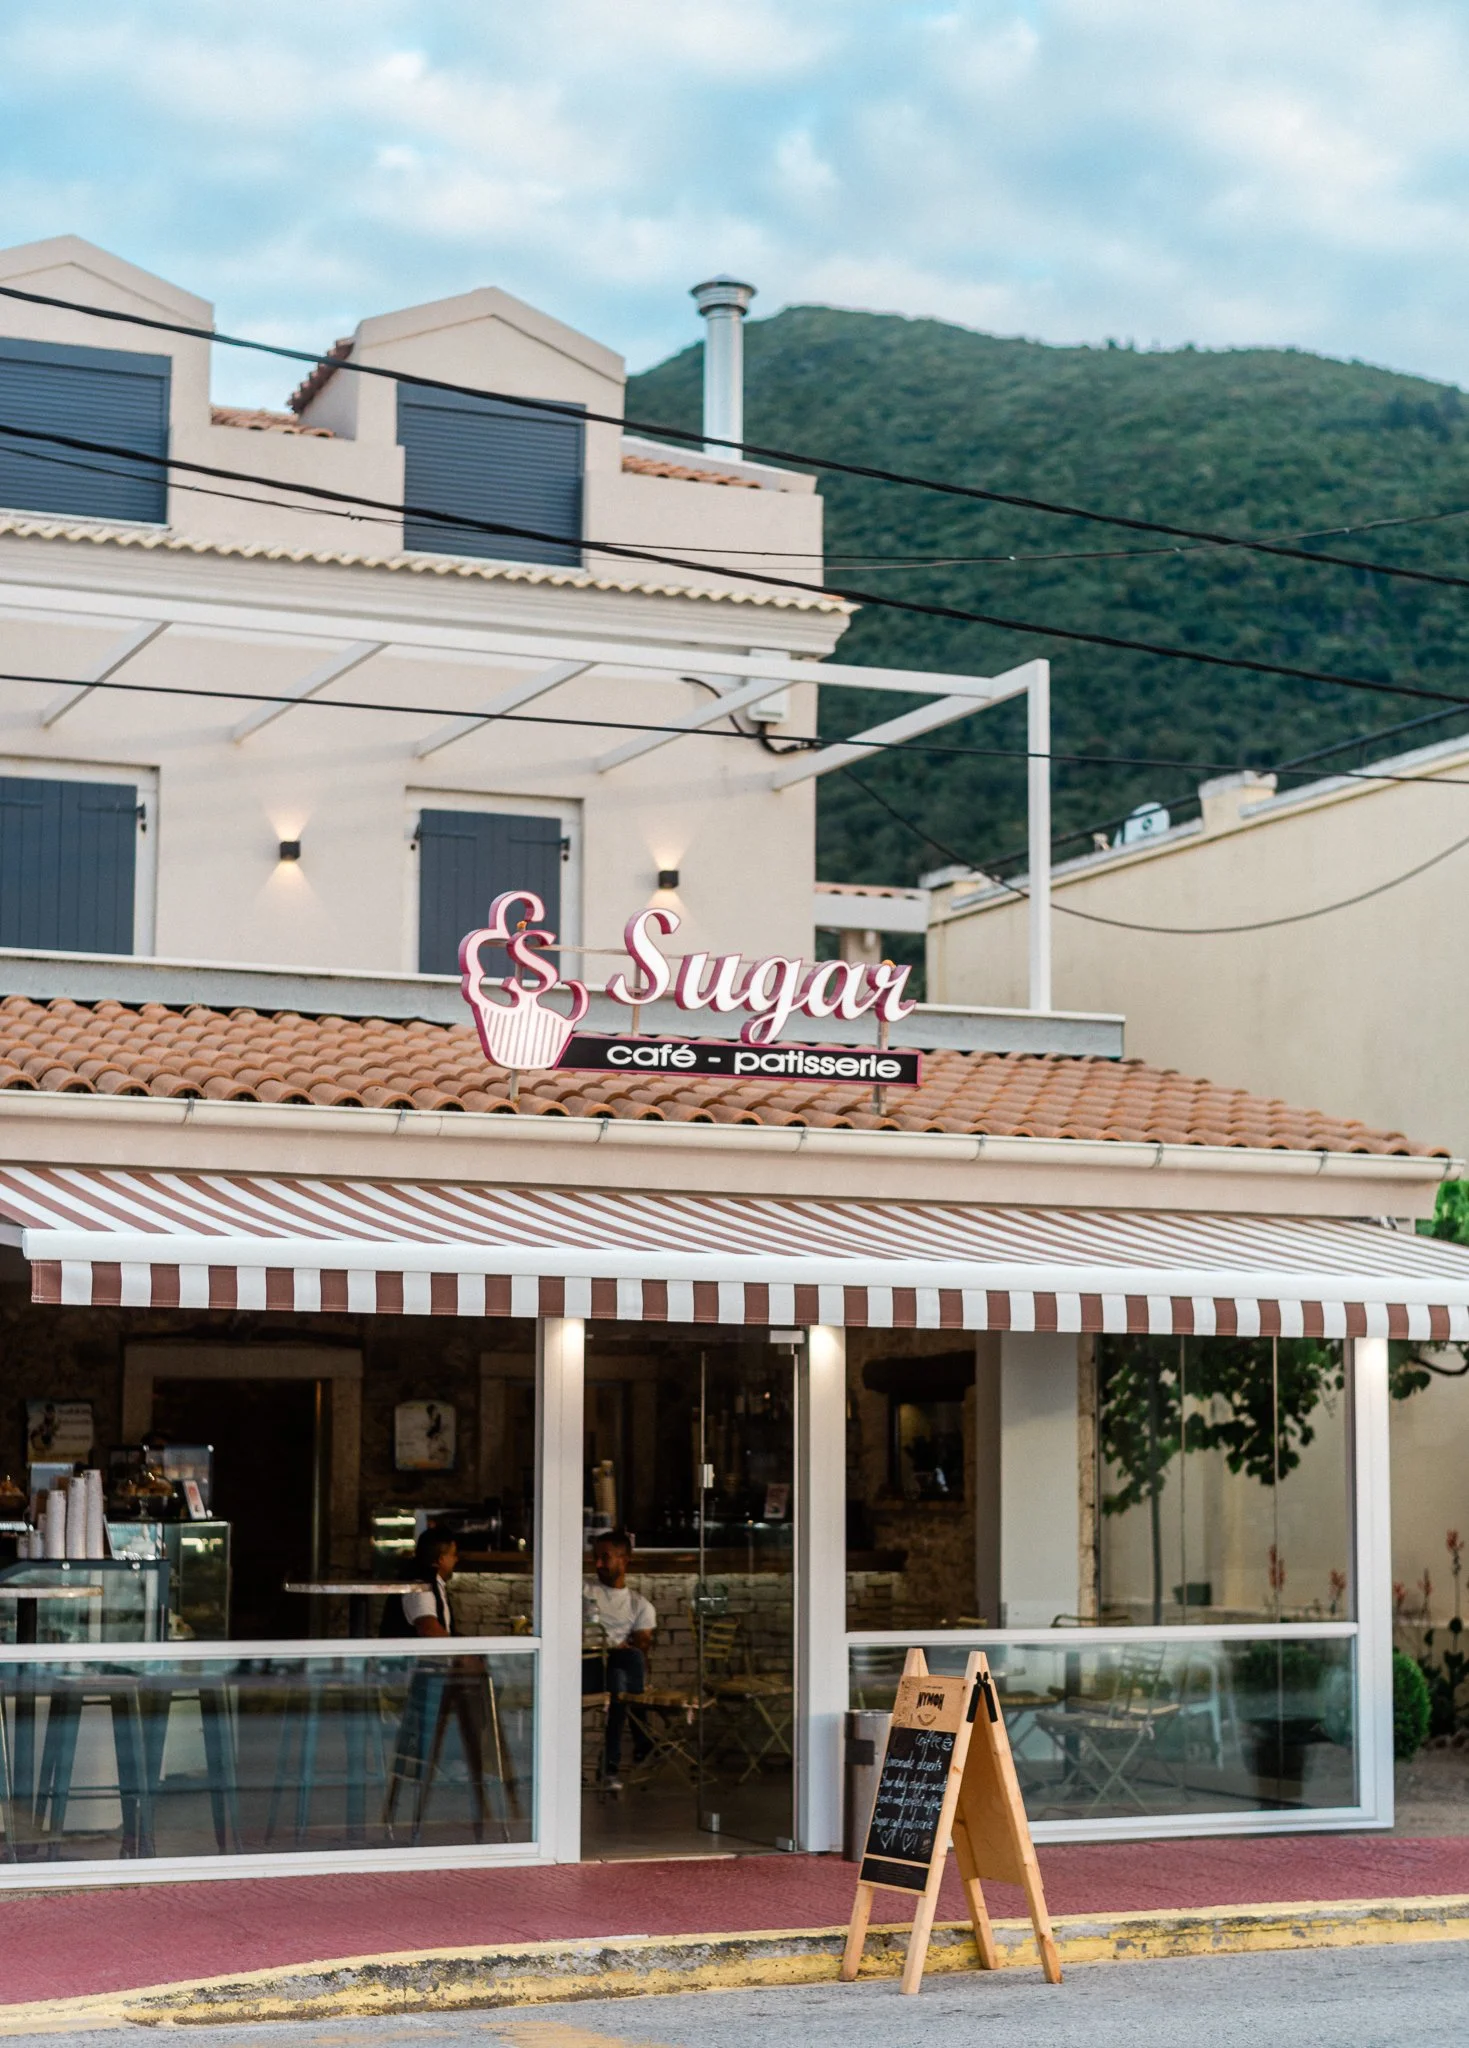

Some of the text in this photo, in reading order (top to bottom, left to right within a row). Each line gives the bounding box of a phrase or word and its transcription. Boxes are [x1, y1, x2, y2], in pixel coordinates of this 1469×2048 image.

[605, 907, 917, 1045] Sugar
[606, 1044, 697, 1068] café
[733, 1050, 902, 1079] patisserie
